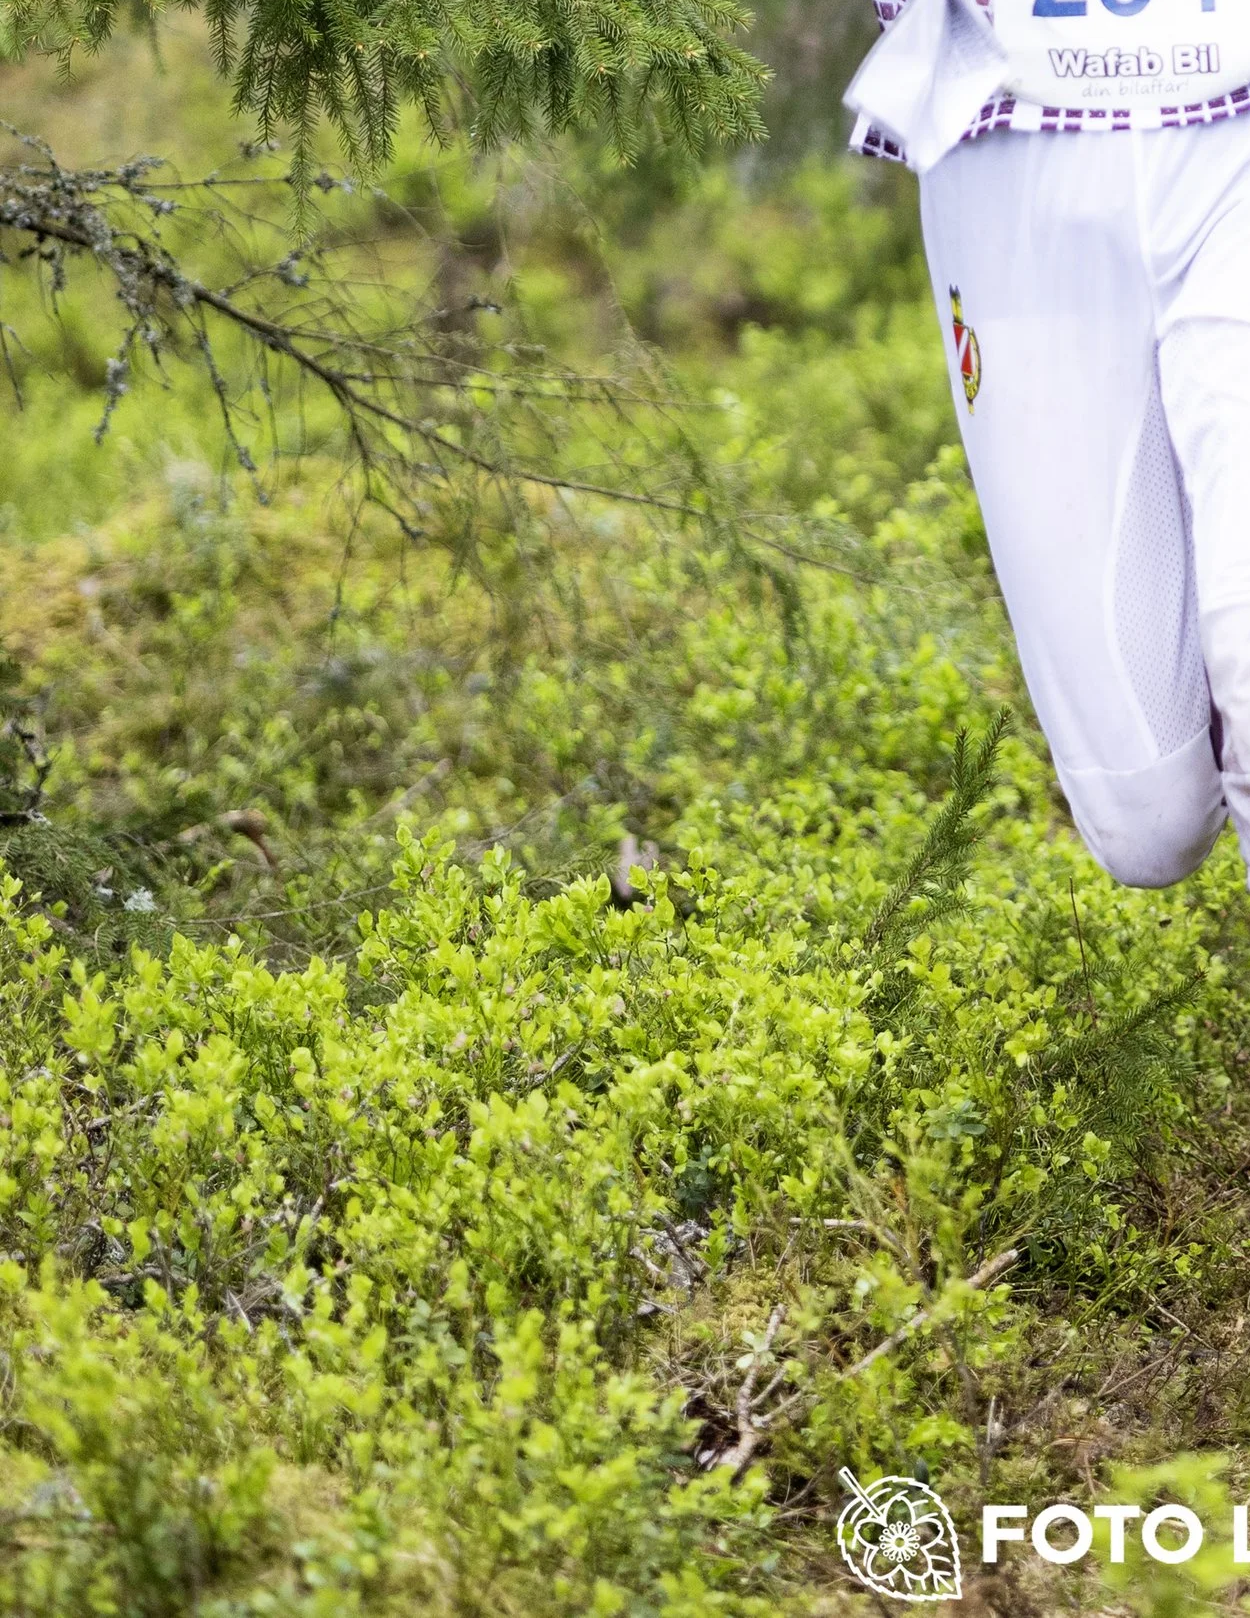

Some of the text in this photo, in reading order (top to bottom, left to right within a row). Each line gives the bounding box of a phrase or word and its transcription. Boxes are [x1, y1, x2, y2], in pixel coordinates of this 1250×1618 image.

[1048, 43, 1220, 78] Wafab Bil
[1081, 81, 1111, 98] din
